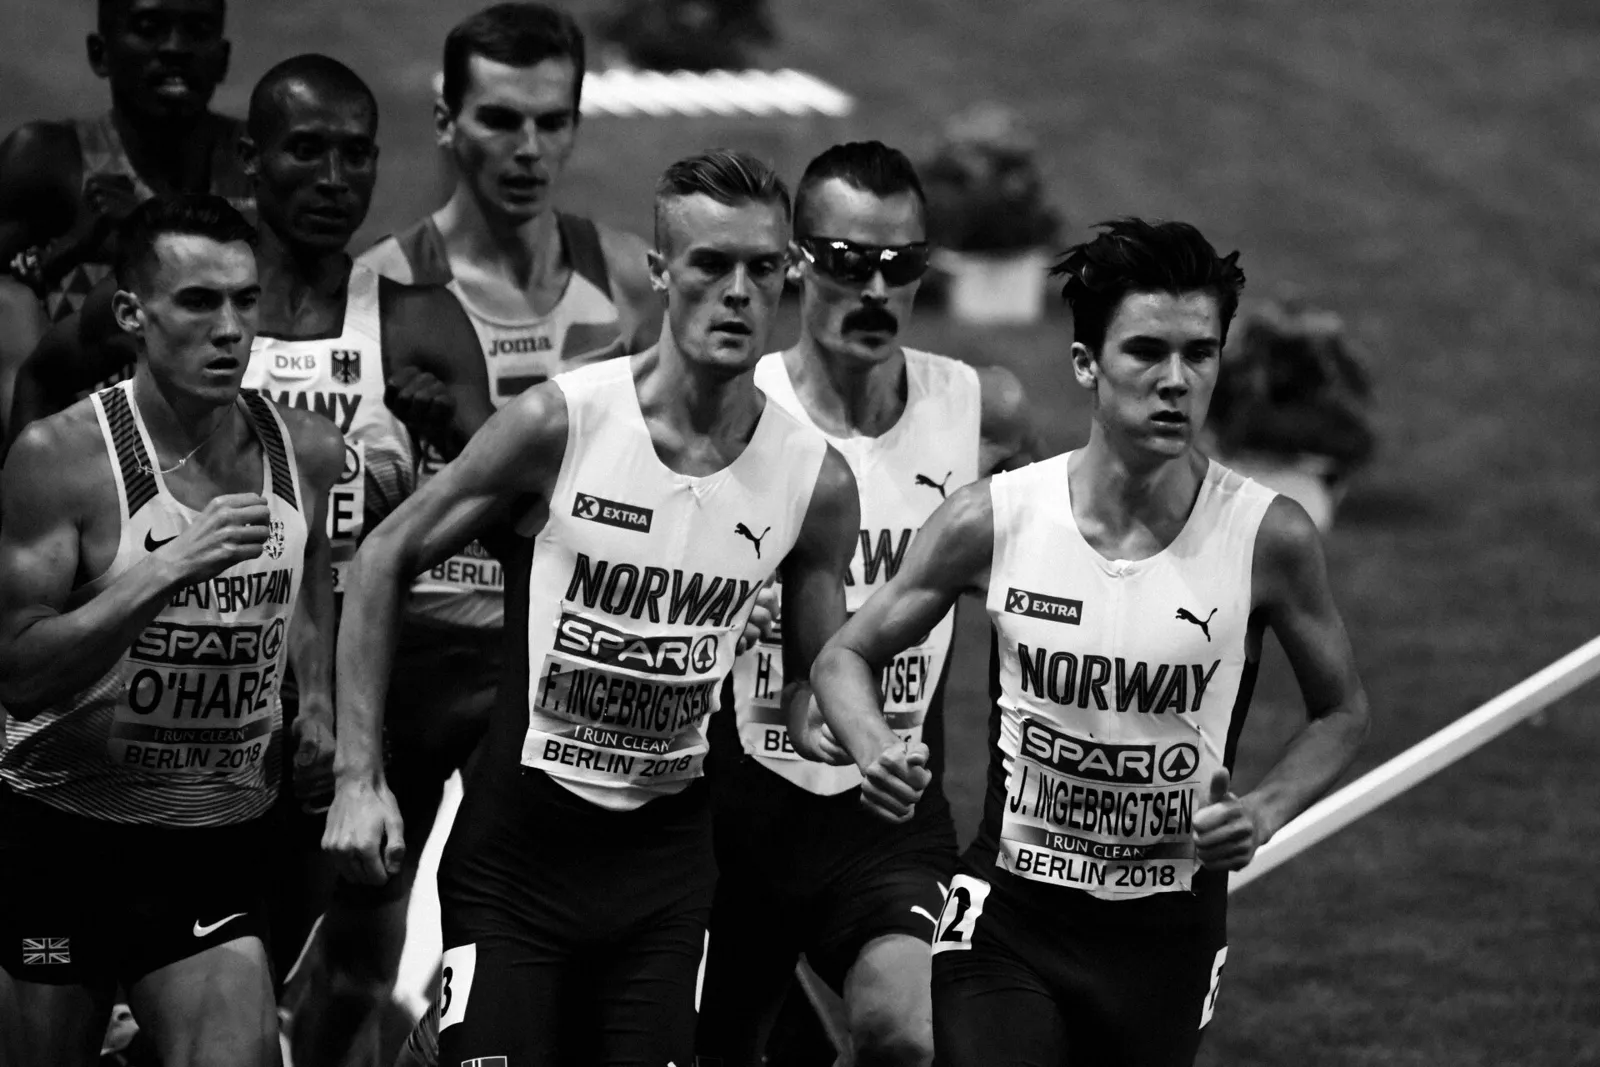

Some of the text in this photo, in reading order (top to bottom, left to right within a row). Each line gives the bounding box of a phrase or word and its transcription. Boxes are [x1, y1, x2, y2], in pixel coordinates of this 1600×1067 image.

[274, 354, 316, 370] DKB
[602, 506, 648, 526] EXTRA
[213, 568, 293, 613] BRITAIN
[565, 552, 763, 628] NORWAY
[1032, 600, 1078, 618] EXTRA
[136, 627, 258, 660] SPAR
[559, 620, 688, 670] SPAR
[128, 664, 276, 719] O'HARE
[755, 652, 774, 699] H.
[1018, 642, 1221, 714] NORWAY
[541, 663, 716, 732] F. INGEBRIGTSEN
[163, 730, 195, 742] RUN
[200, 728, 246, 742] CLEAN
[583, 728, 618, 746] RUN
[622, 736, 672, 752] CLEAN
[1026, 726, 1150, 778] SPAR
[124, 742, 262, 769] BERLIN 2018
[542, 739, 692, 777] BERLIN 2018
[1010, 766, 1193, 837] J. INGEBRIGTSEN
[1054, 836, 1088, 853] RUN
[1093, 845, 1146, 858] CLEAN
[1015, 848, 1175, 887] BERLIN 2018
